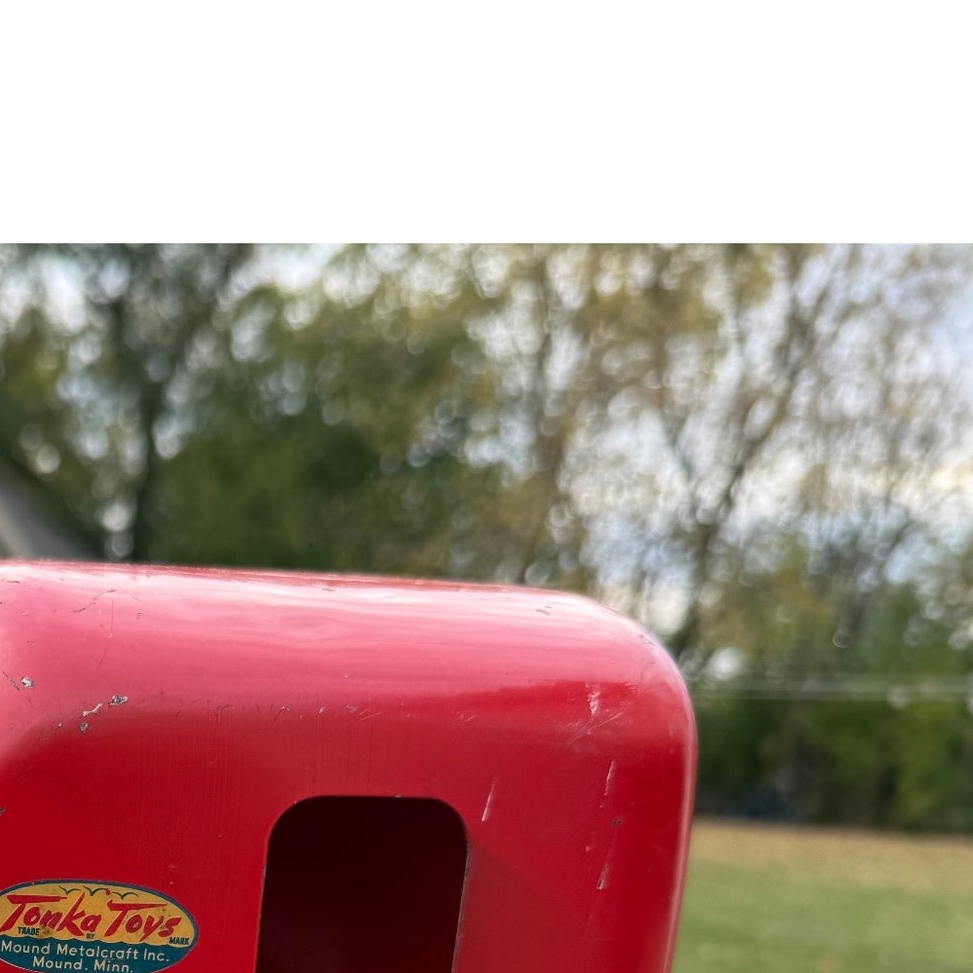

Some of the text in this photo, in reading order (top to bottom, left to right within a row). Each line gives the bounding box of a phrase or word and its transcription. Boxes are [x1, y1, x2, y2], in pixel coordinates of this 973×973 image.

[104, 899, 182, 942] Toys
[17, 926, 190, 946] TRADE MARK
[0, 940, 170, 962] Mound Metalcraft Inc.
[93, 959, 134, 973] Minn.
